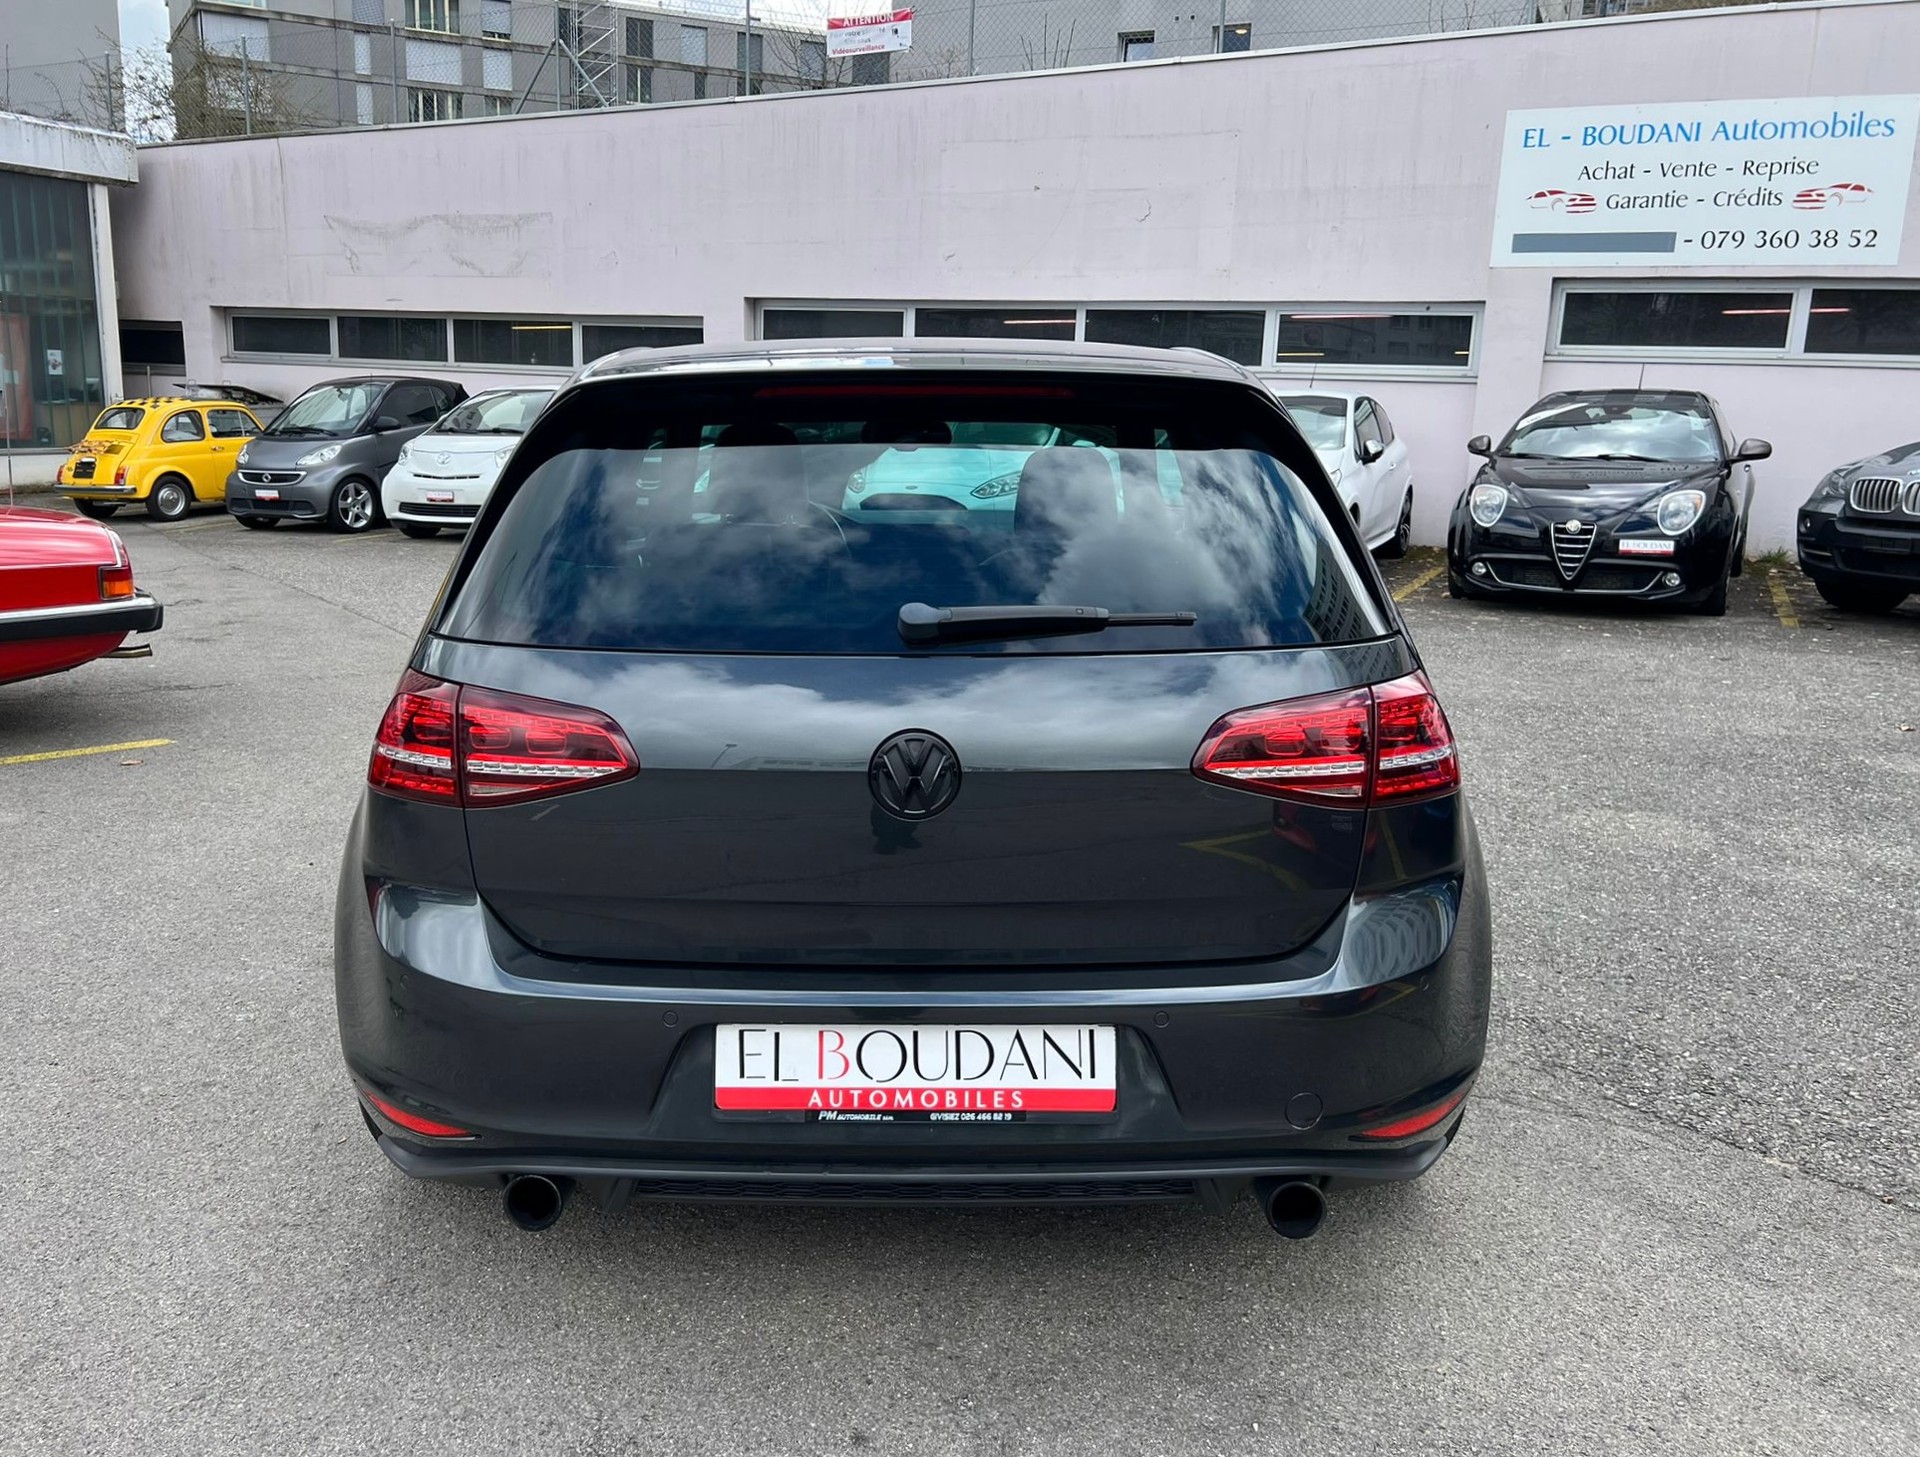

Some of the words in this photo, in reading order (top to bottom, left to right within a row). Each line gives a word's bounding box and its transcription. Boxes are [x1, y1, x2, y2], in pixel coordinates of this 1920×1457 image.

[843, 13, 894, 27] ATTENTION
[831, 44, 885, 55] Vidéosurveillance
[1522, 128, 1550, 148] EL
[1581, 122, 1701, 147] BOUDANI
[1711, 111, 1896, 143] Automobiles
[1578, 161, 1636, 181] Achat
[1660, 160, 1717, 179] Vente
[1742, 156, 1820, 182] Reprise
[1606, 190, 1689, 210] Garantie
[1713, 187, 1784, 208] Crédits
[1700, 230, 1745, 249] 079
[1755, 230, 1799, 249] 360
[1808, 230, 1838, 249] 38
[1847, 229, 1879, 248] 52
[739, 1029, 799, 1081] EL
[818, 1029, 1095, 1082] BOUDANI
[808, 1090, 1024, 1109] AUTOMOBILES
[818, 1110, 837, 1120] PM
[961, 1112, 976, 1120] 026
